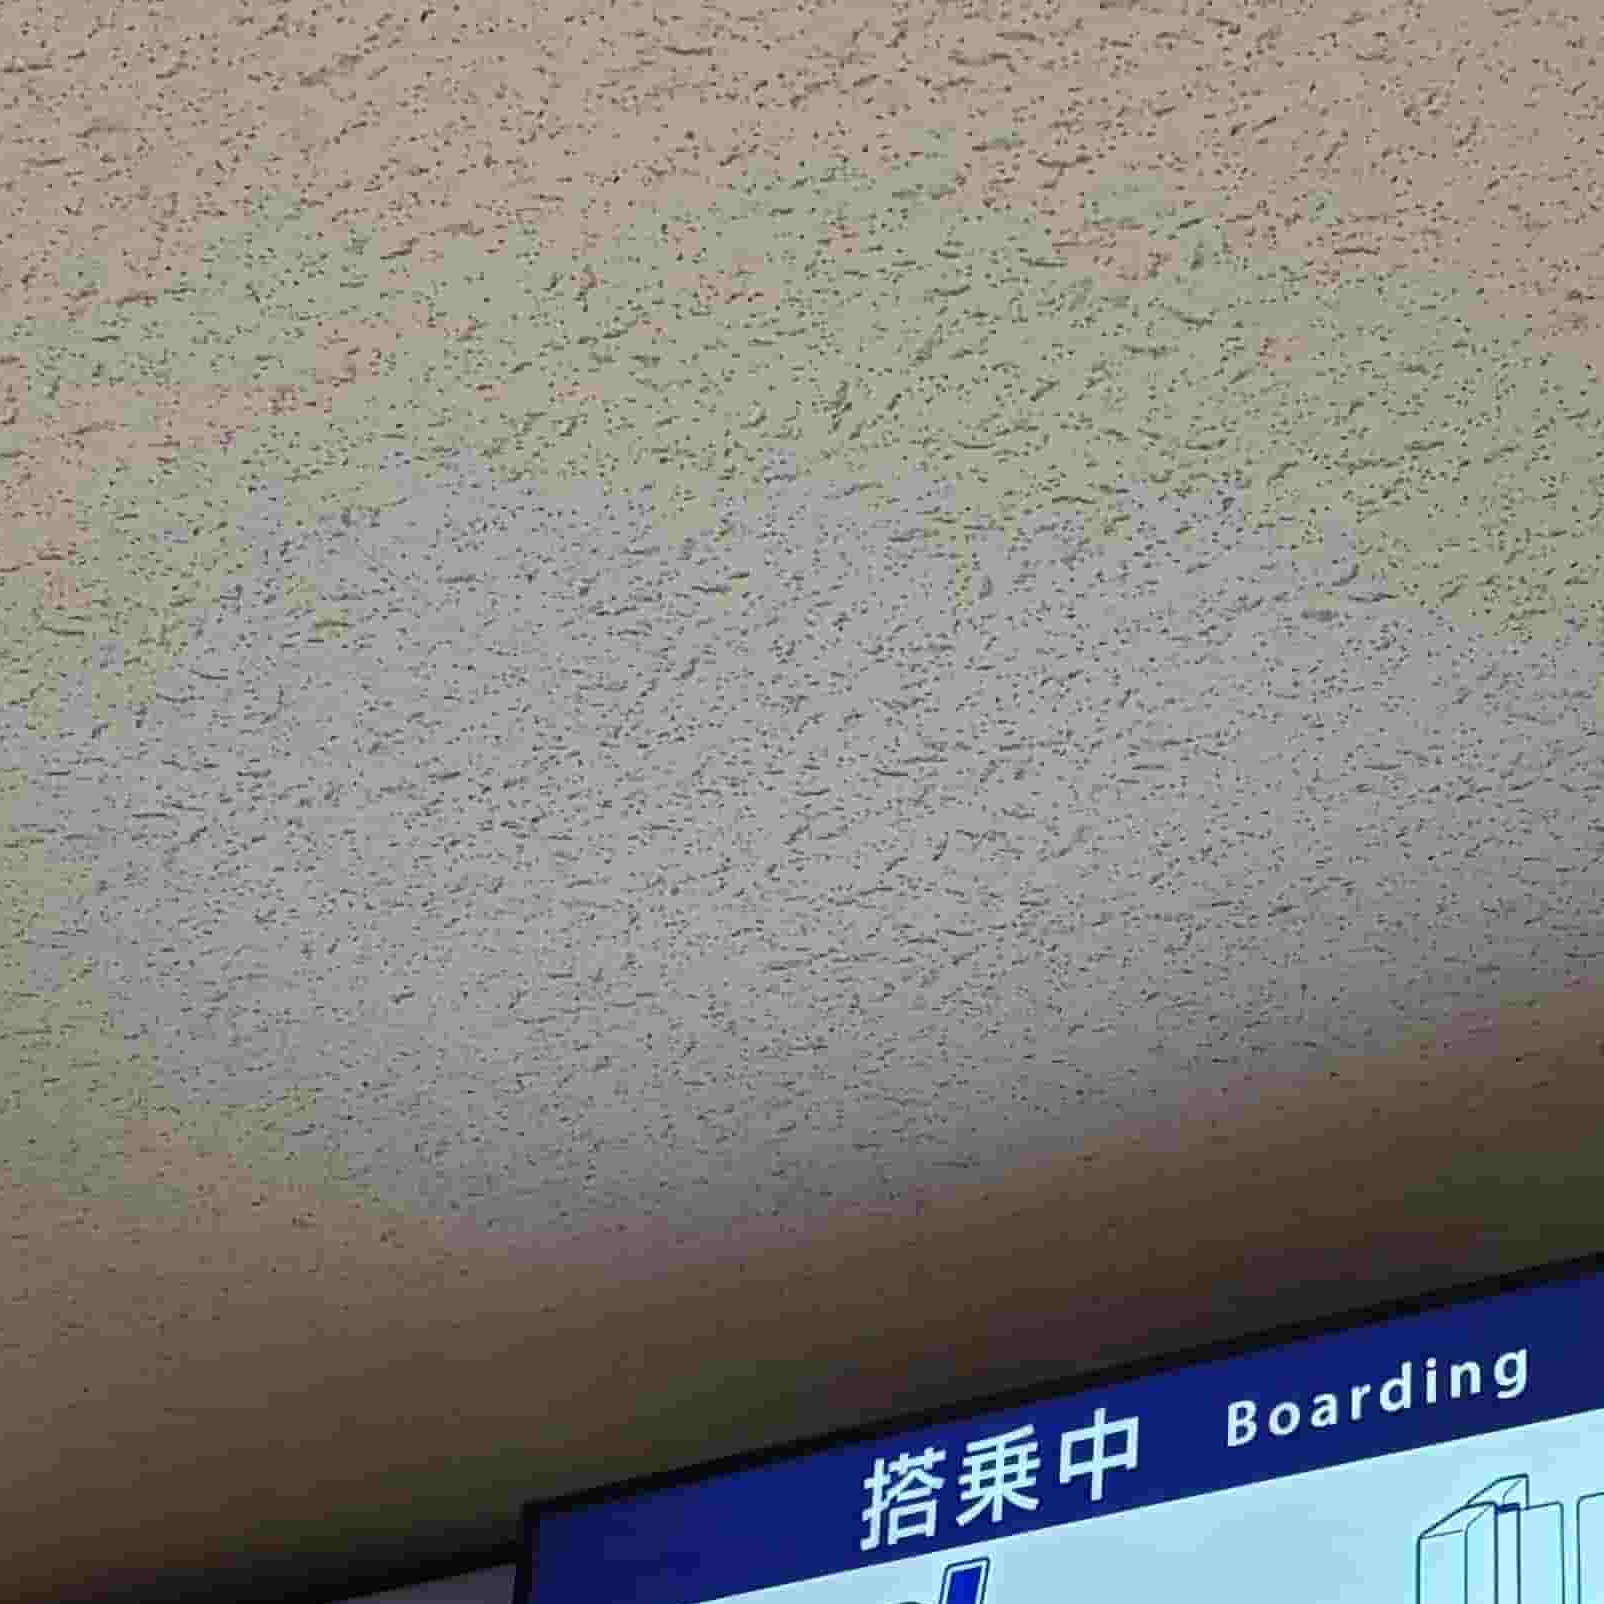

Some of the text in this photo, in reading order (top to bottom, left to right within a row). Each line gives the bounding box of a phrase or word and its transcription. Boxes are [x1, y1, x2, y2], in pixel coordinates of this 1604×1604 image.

[859, 1342, 1531, 1550] 搭乗中 Boarding
